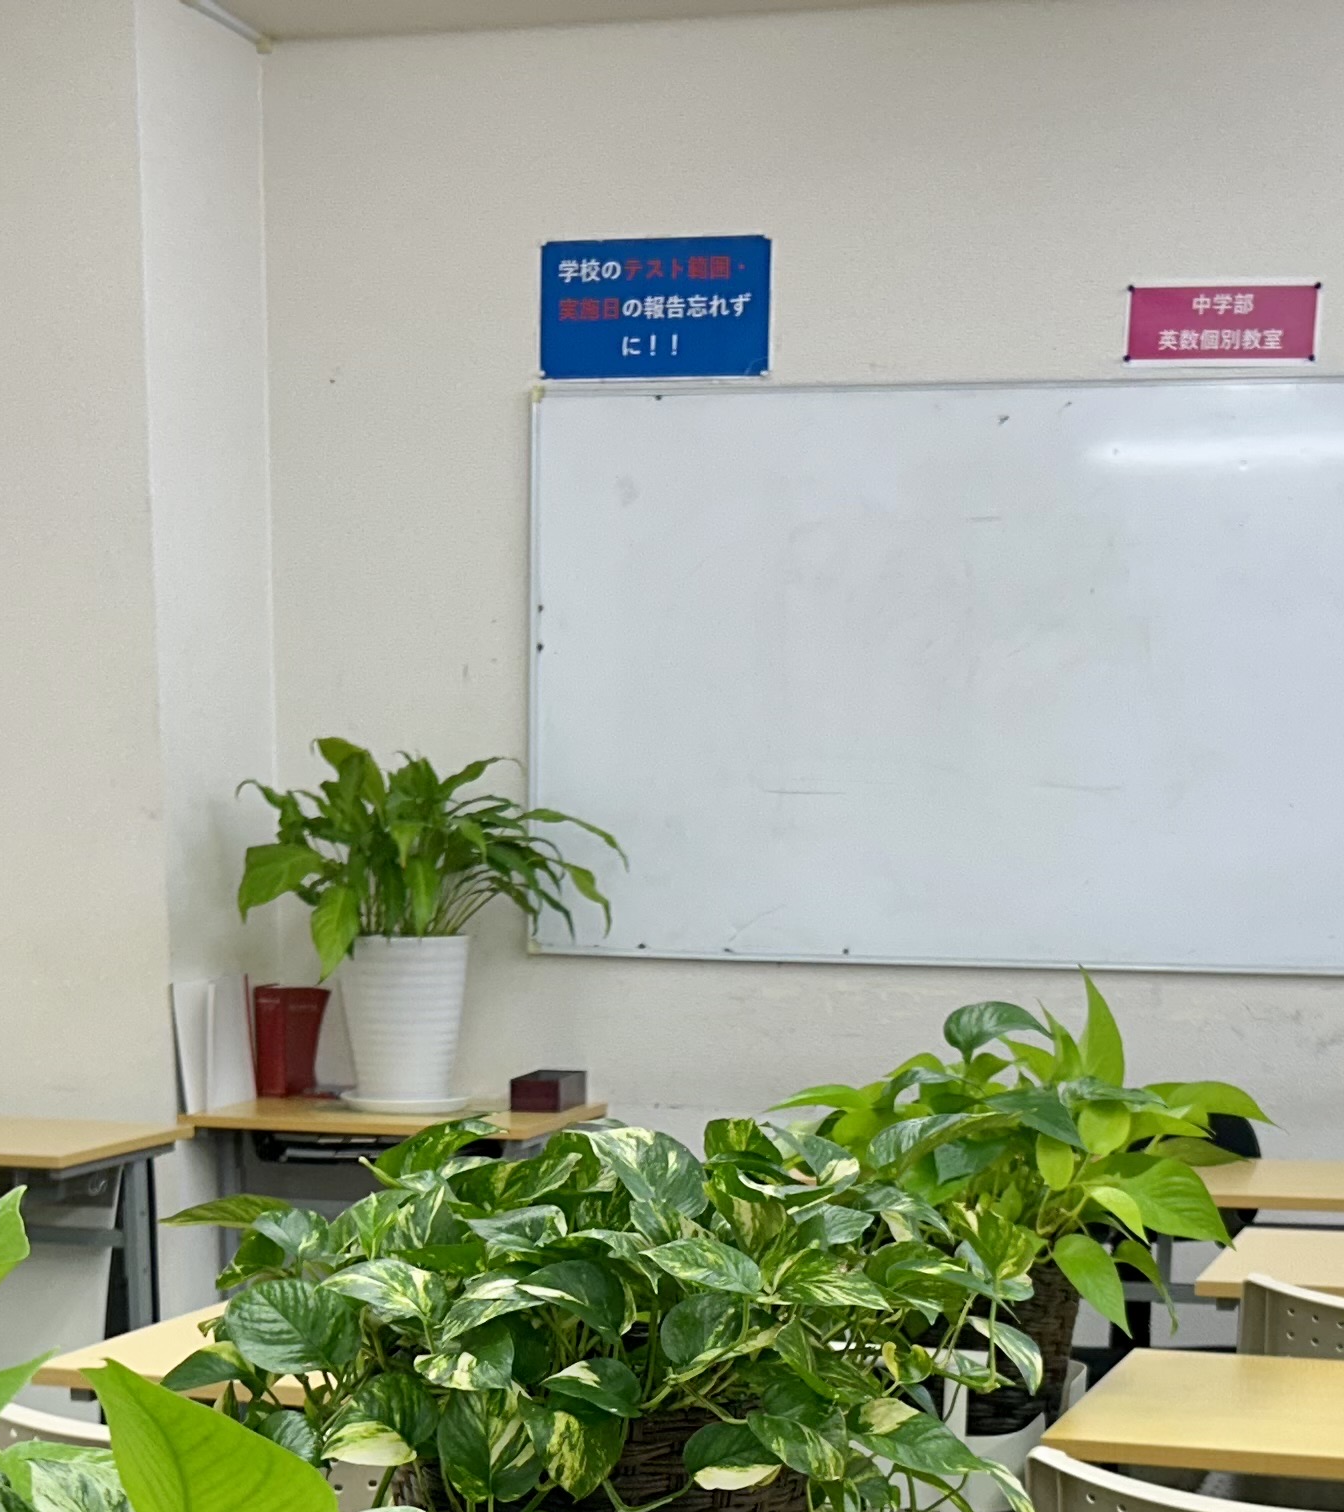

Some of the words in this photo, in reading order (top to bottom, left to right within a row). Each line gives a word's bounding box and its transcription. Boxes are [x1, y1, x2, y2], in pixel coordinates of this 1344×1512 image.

[558, 292, 752, 321] 実施日の報告忘れず
[1191, 293, 1255, 315] 中学部
[621, 333, 680, 357] に！！
[1157, 328, 1284, 351] 英数個別教室
